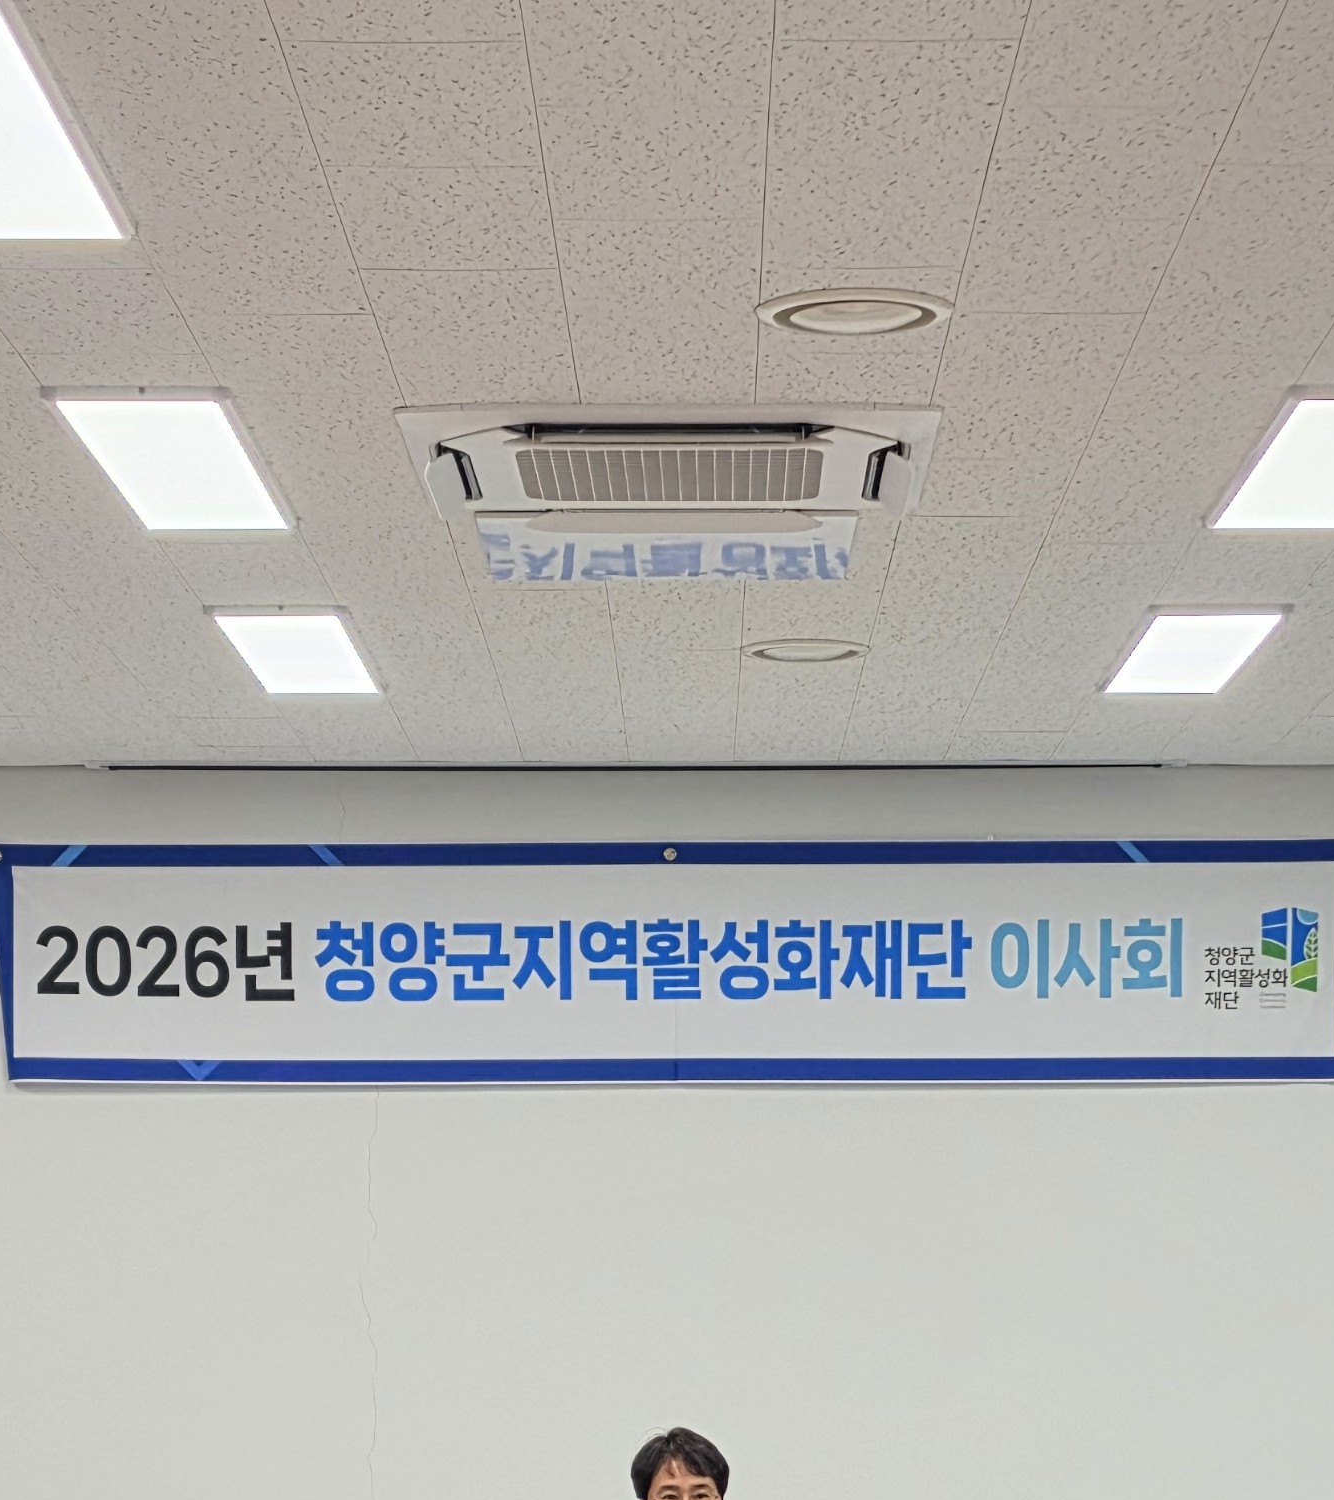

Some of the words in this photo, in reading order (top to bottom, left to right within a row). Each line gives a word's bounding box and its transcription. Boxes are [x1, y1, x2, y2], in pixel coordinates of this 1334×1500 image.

[36, 922, 297, 1002] 2026년
[312, 917, 972, 1002] 청양군지역활성화재단
[988, 917, 1185, 999] 이사회
[1204, 947, 1255, 965] 청양군
[1204, 968, 1288, 988] 지역활성화
[1204, 991, 1239, 1010] 재단
